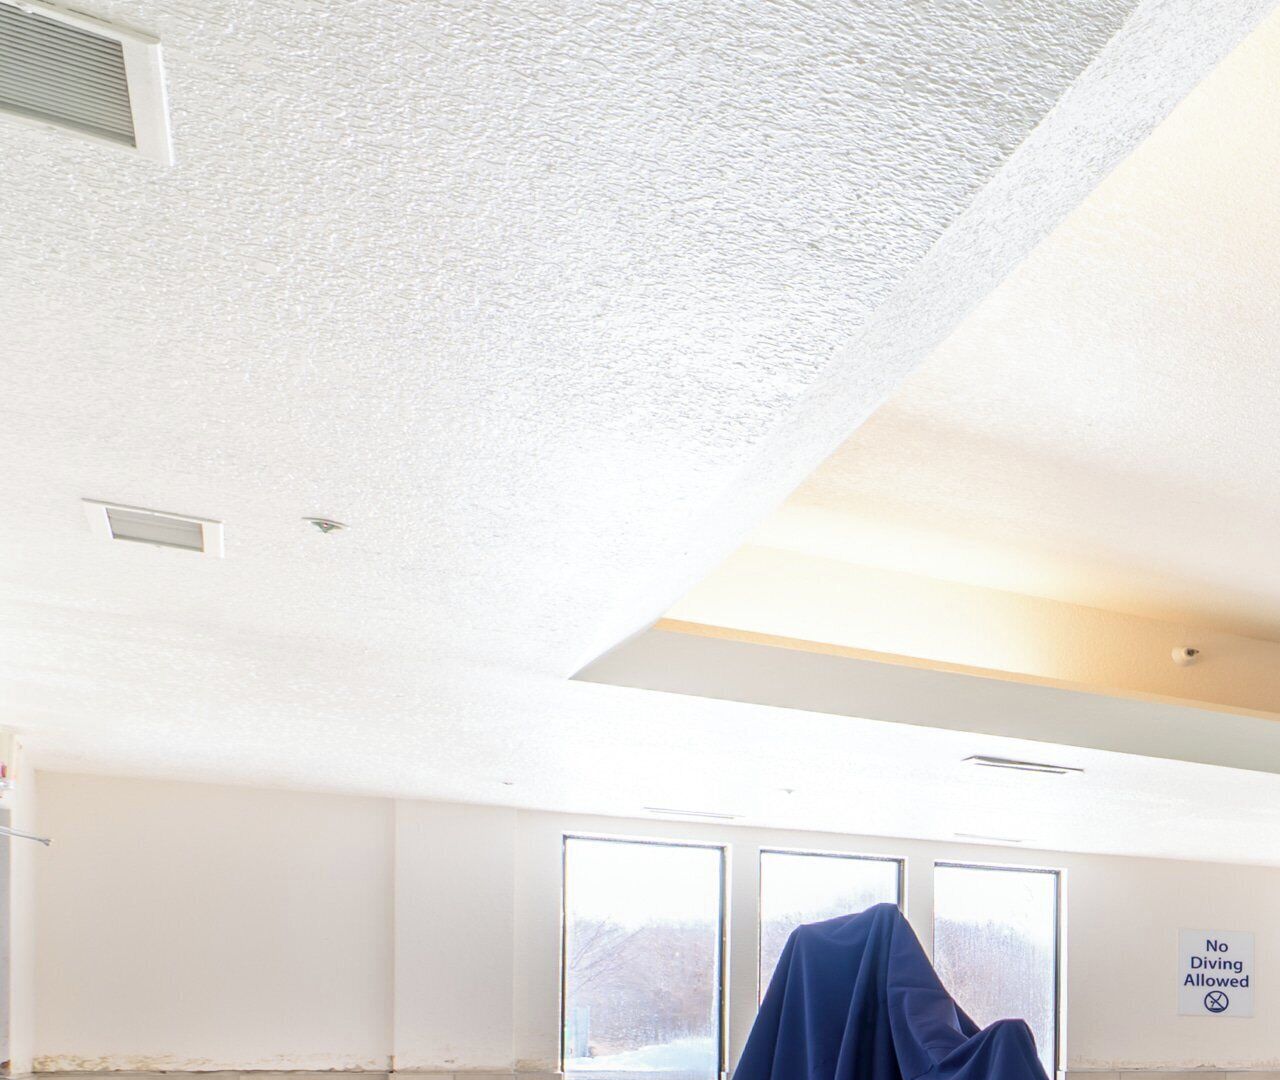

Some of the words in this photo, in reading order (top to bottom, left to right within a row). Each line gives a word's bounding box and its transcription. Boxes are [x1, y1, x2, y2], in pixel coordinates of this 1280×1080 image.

[1206, 939, 1228, 953] No
[1190, 956, 1243, 974] Diving
[1183, 973, 1249, 988] Allowed
